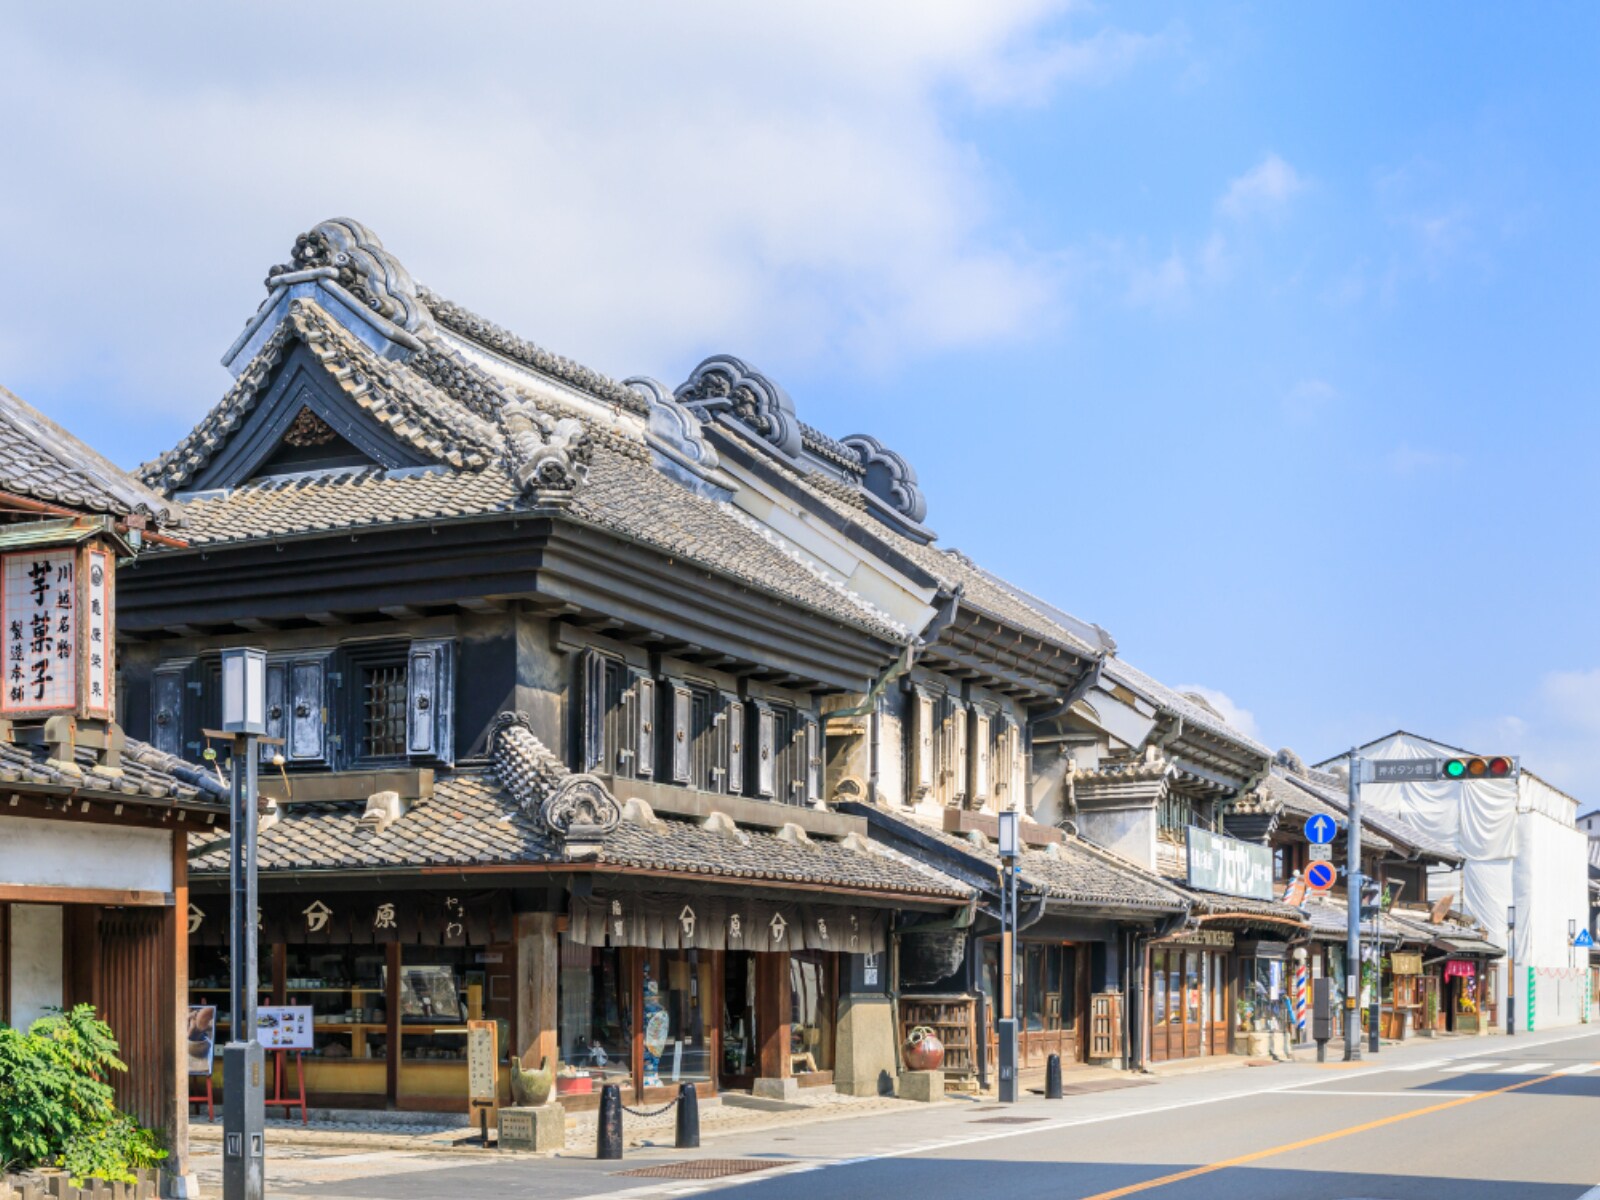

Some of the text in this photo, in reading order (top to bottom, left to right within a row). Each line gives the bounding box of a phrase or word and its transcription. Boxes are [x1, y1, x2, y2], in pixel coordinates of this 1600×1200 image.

[27, 560, 54, 702] 芋菓子
[56, 562, 73, 660] 川越名物
[9, 619, 25, 704] 製造本舗
[374, 902, 398, 929] 原
